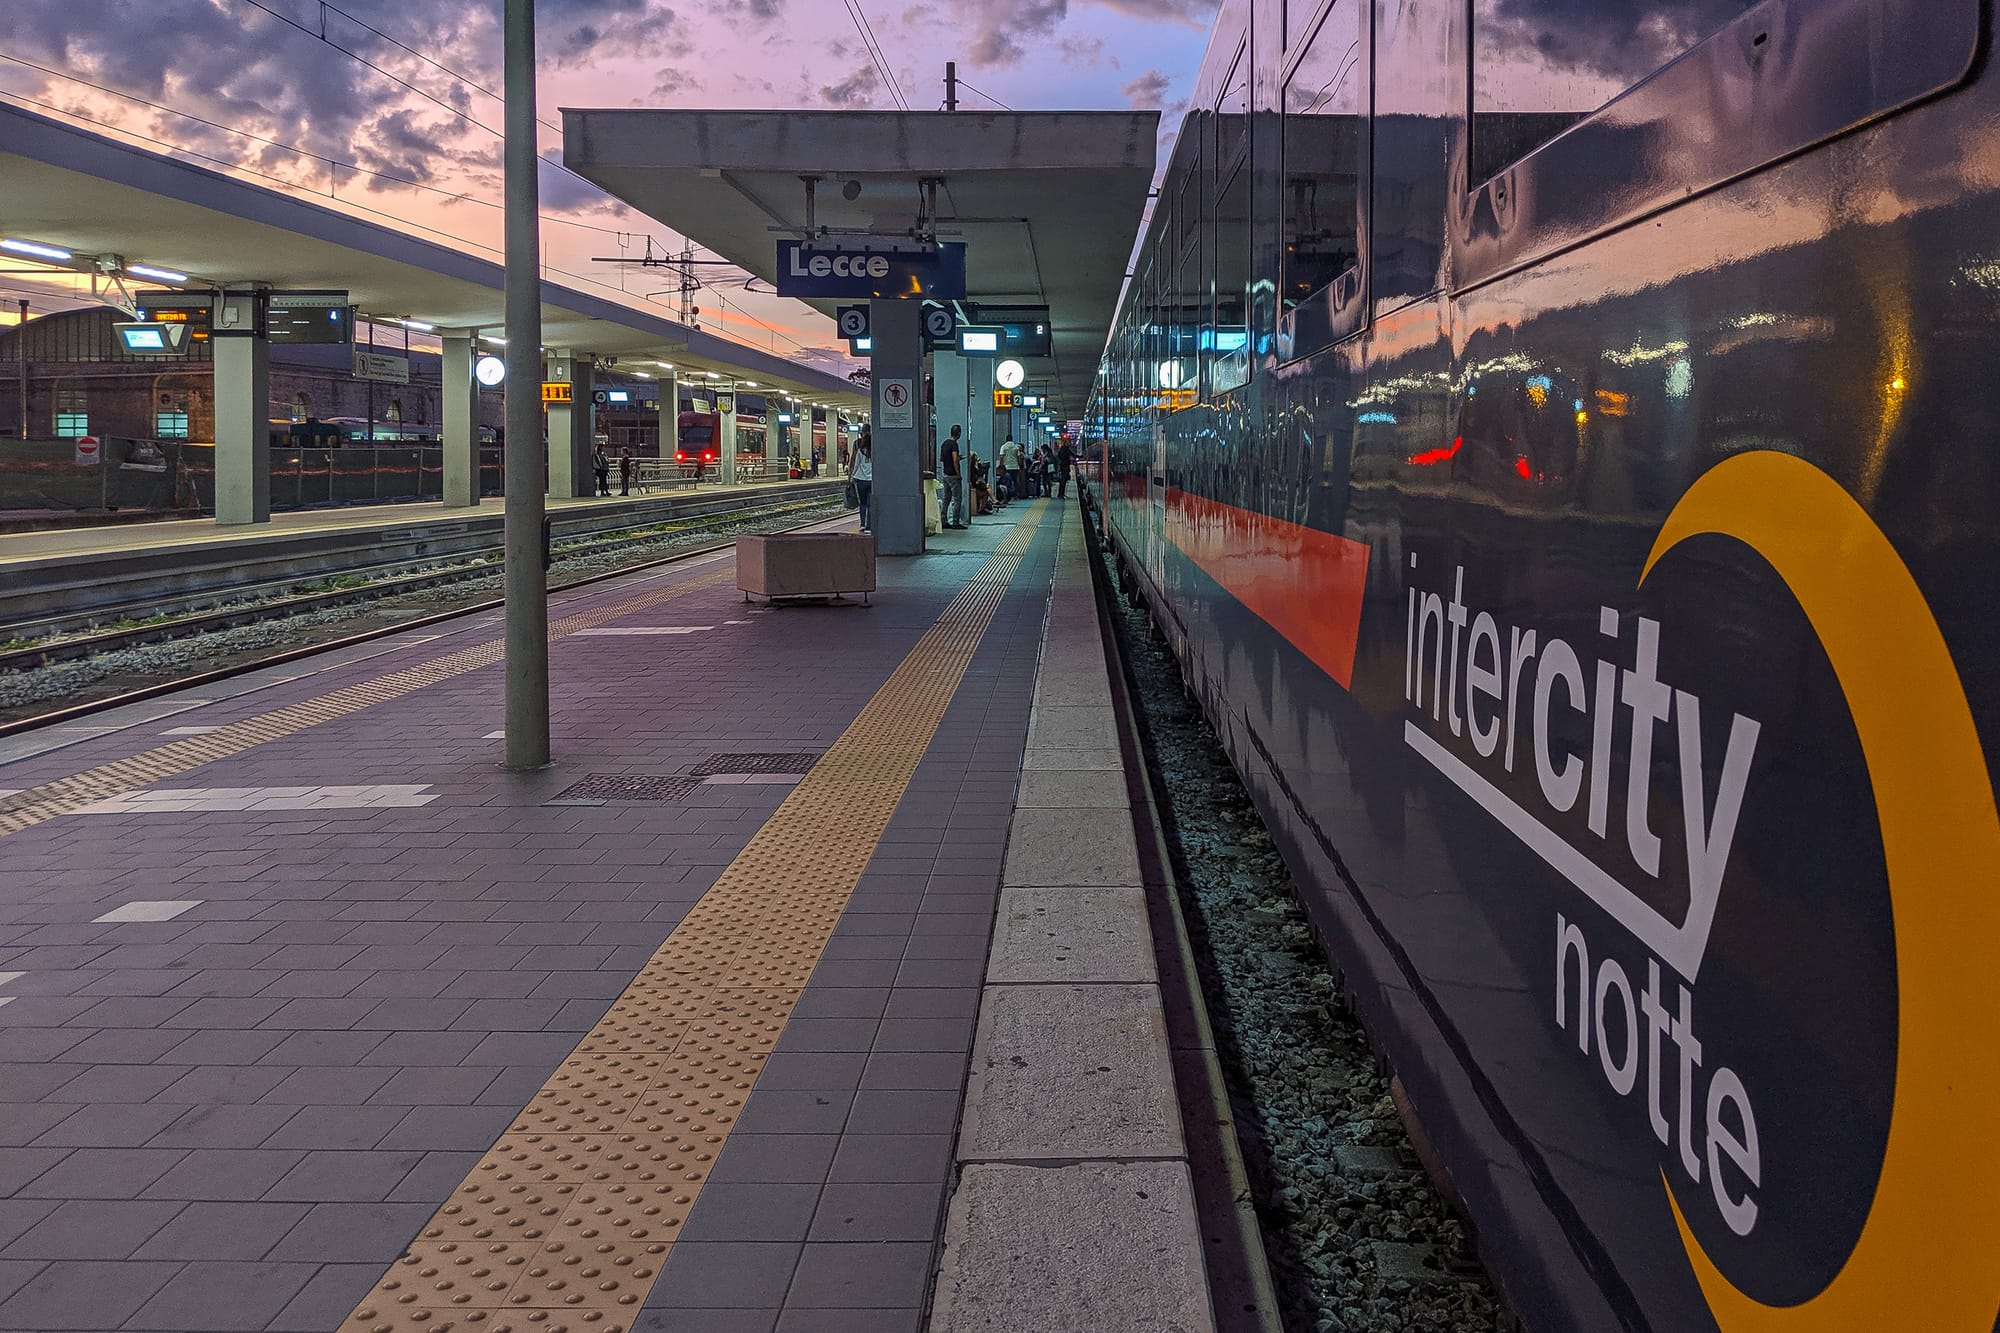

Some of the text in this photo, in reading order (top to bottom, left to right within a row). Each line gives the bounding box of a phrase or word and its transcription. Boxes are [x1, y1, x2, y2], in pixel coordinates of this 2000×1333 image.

[790, 246, 889, 278] Lecce
[847, 315, 860, 330] 3
[934, 315, 946, 331] 2
[1036, 325, 1044, 335] 2
[1405, 552, 1761, 984] intercity
[1556, 912, 1761, 1236] notte
